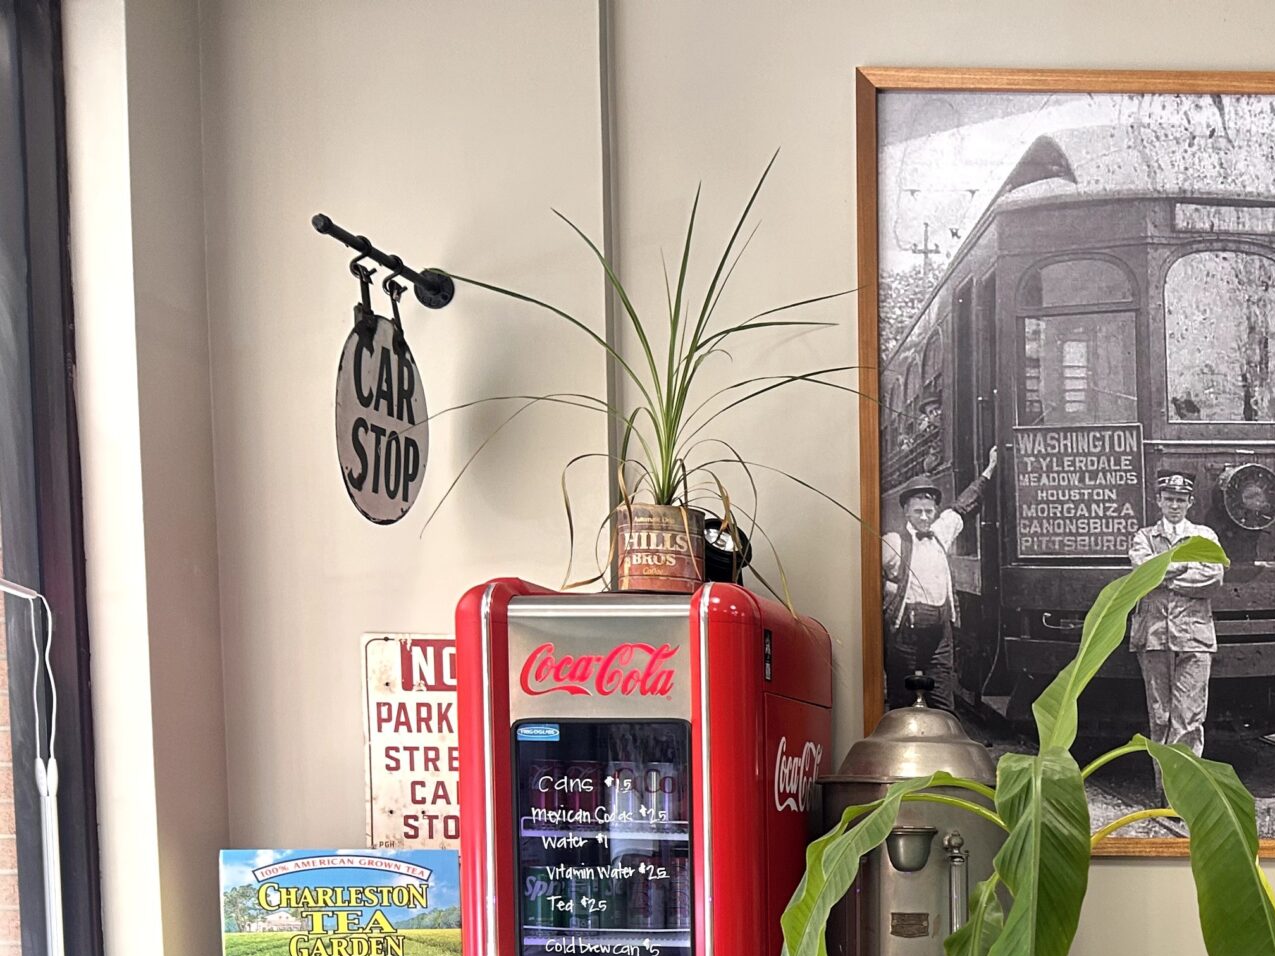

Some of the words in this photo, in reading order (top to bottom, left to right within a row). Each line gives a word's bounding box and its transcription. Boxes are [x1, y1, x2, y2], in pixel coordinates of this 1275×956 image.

[353, 345, 416, 426] CAR
[1018, 430, 1138, 455] WASHINGTON
[349, 416, 420, 503] STOP
[1023, 456, 1133, 472] TYLERDALE
[1020, 473, 1080, 486] MEADOW
[1085, 472, 1138, 485] LANDS
[1037, 489, 1117, 500] HOUSTON
[1022, 502, 1135, 517] MORGANZA
[1020, 519, 1139, 534] CANONSBURG
[624, 532, 688, 552] HILLS
[632, 552, 676, 566] BROS
[520, 641, 681, 697] Coca-Cola
[410, 780, 461, 805] CA
[538, 776, 594, 792] Cans
[541, 833, 589, 849] Water
[260, 865, 289, 879] 100%
[292, 857, 355, 870] AMERICAN
[358, 857, 402, 872] GROWN
[405, 865, 426, 879] TEA
[546, 863, 595, 880] Vitamin
[596, 861, 636, 880] Water
[257, 881, 429, 911] CHARLESTON
[546, 896, 575, 912] Tea
[301, 909, 398, 935] TEA
[578, 936, 612, 954] brew
